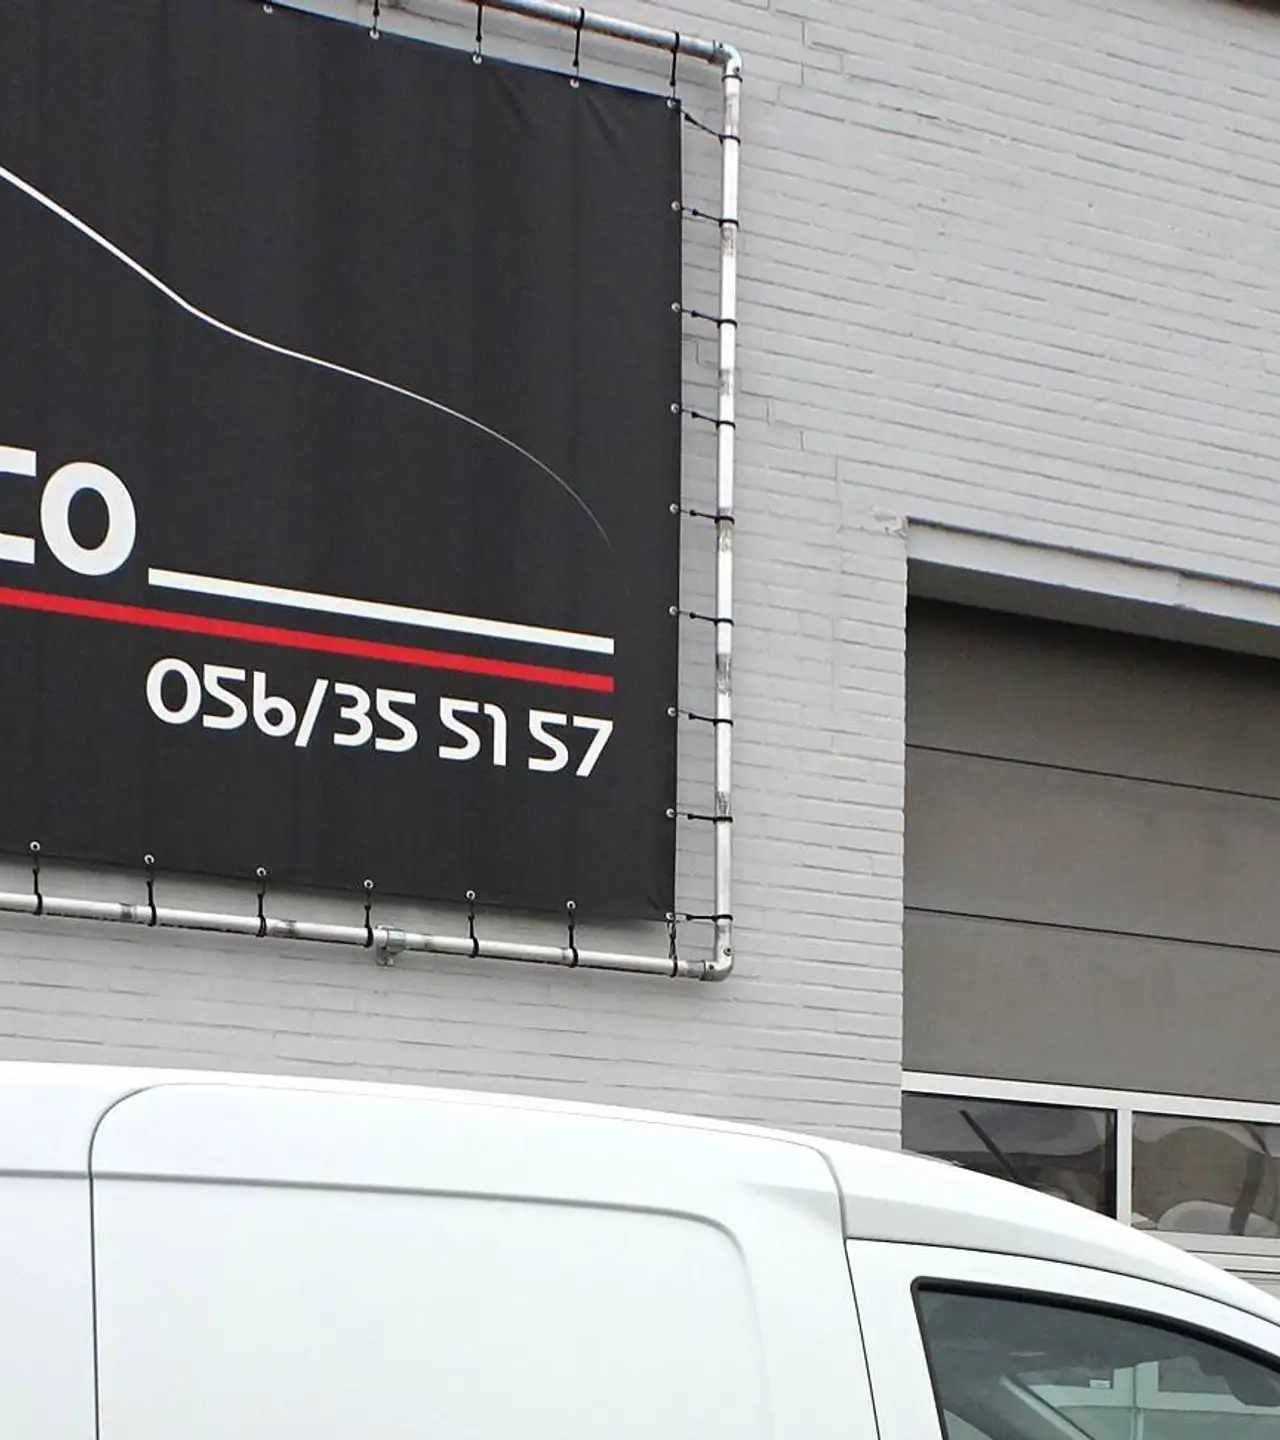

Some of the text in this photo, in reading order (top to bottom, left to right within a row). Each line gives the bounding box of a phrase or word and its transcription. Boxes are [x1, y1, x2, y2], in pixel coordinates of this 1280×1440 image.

[146, 658, 614, 777] 056/35 51 57
